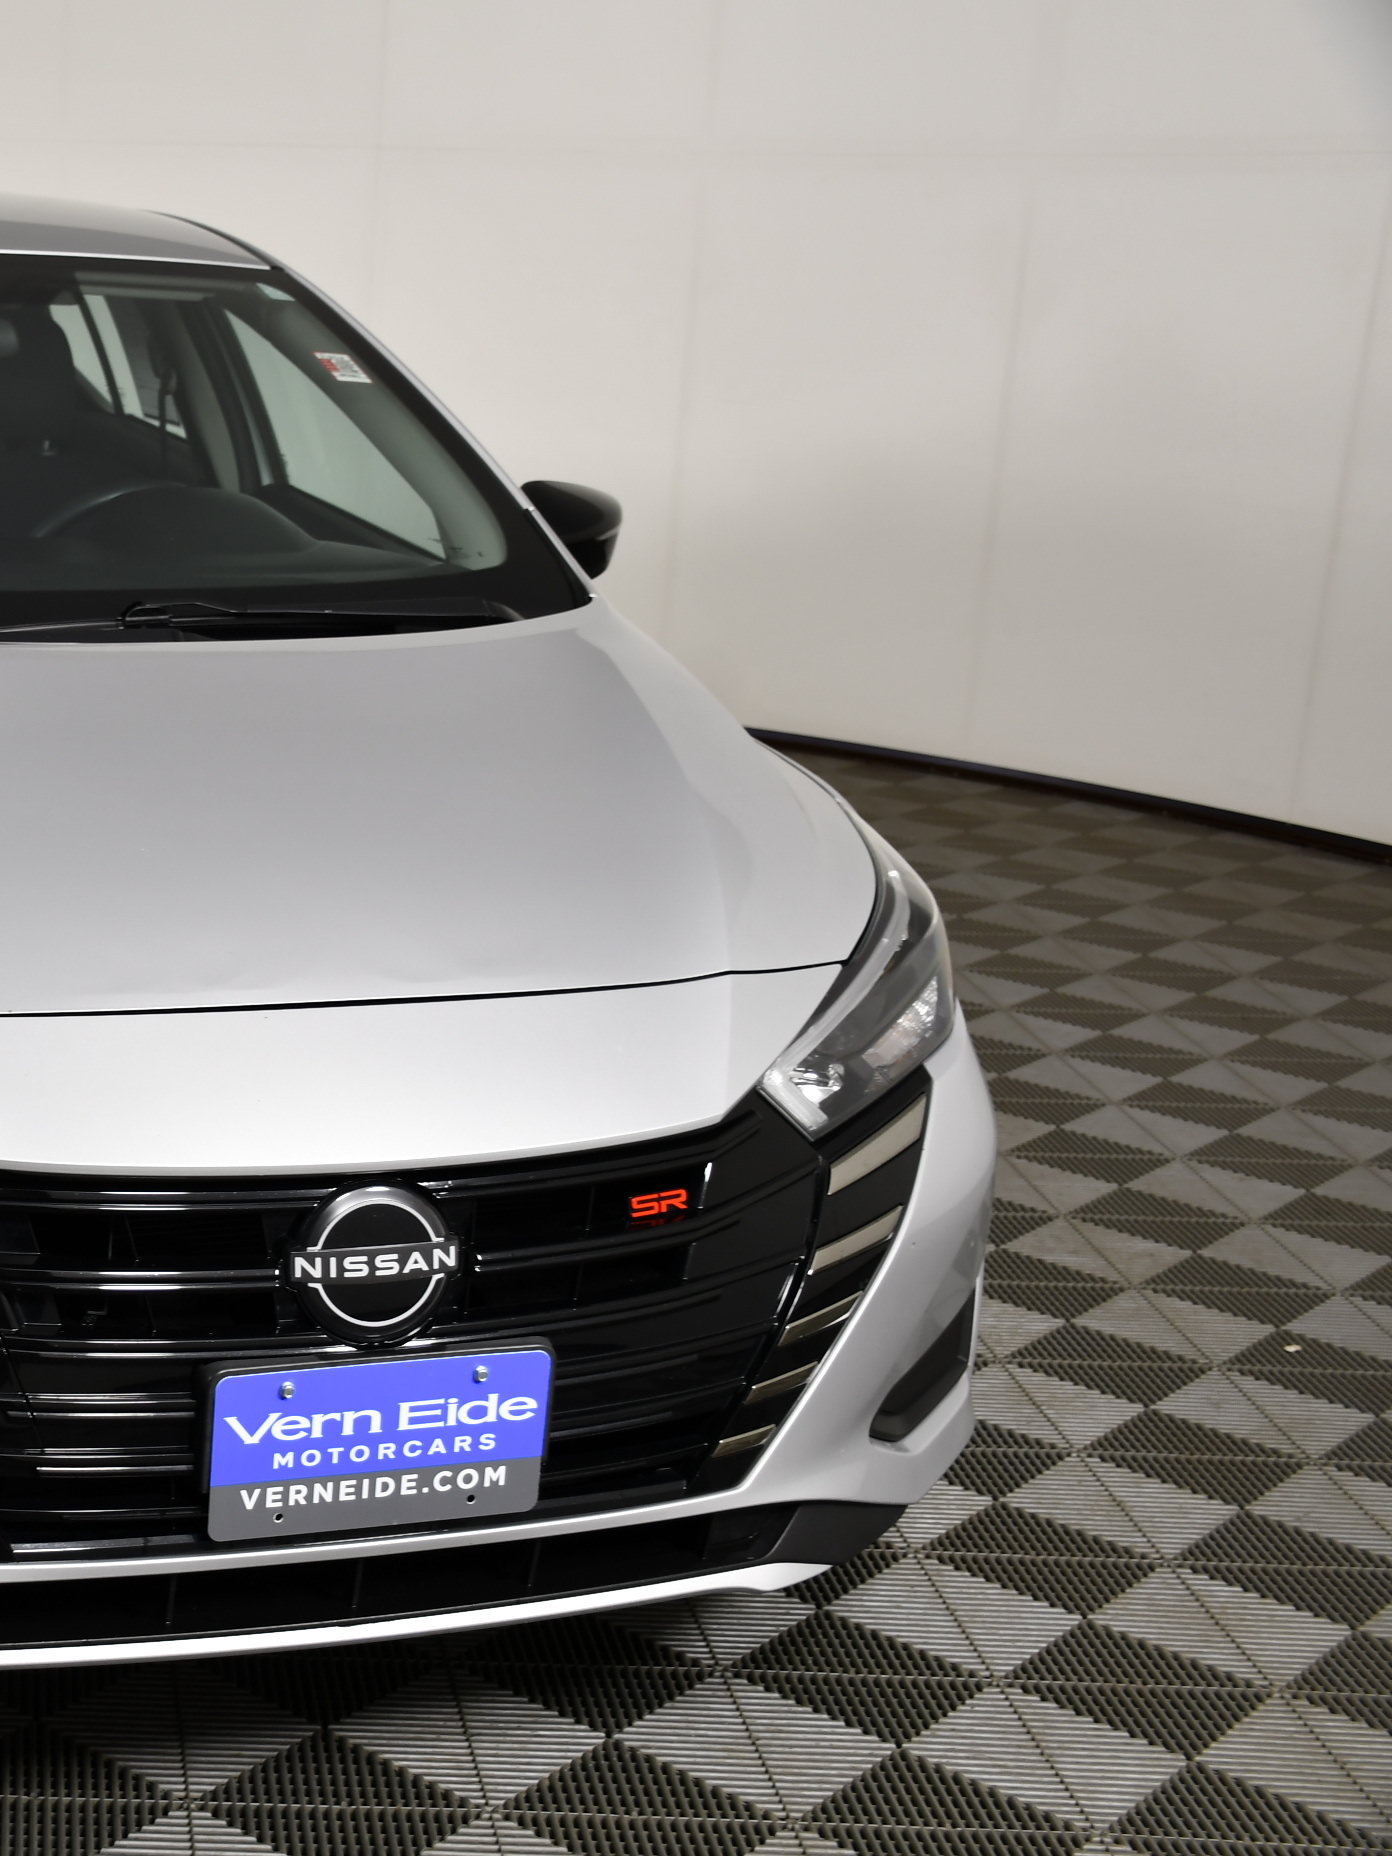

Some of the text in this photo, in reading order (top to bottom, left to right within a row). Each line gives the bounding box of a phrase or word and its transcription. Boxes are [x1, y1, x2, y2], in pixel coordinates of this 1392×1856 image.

[630, 1188, 688, 1218] SR
[294, 1245, 457, 1279] NISSAN
[223, 1393, 538, 1445] Vern Eide
[272, 1433, 497, 1470] MOTORCARS
[239, 1465, 507, 1511] VERNEIDE.COM
